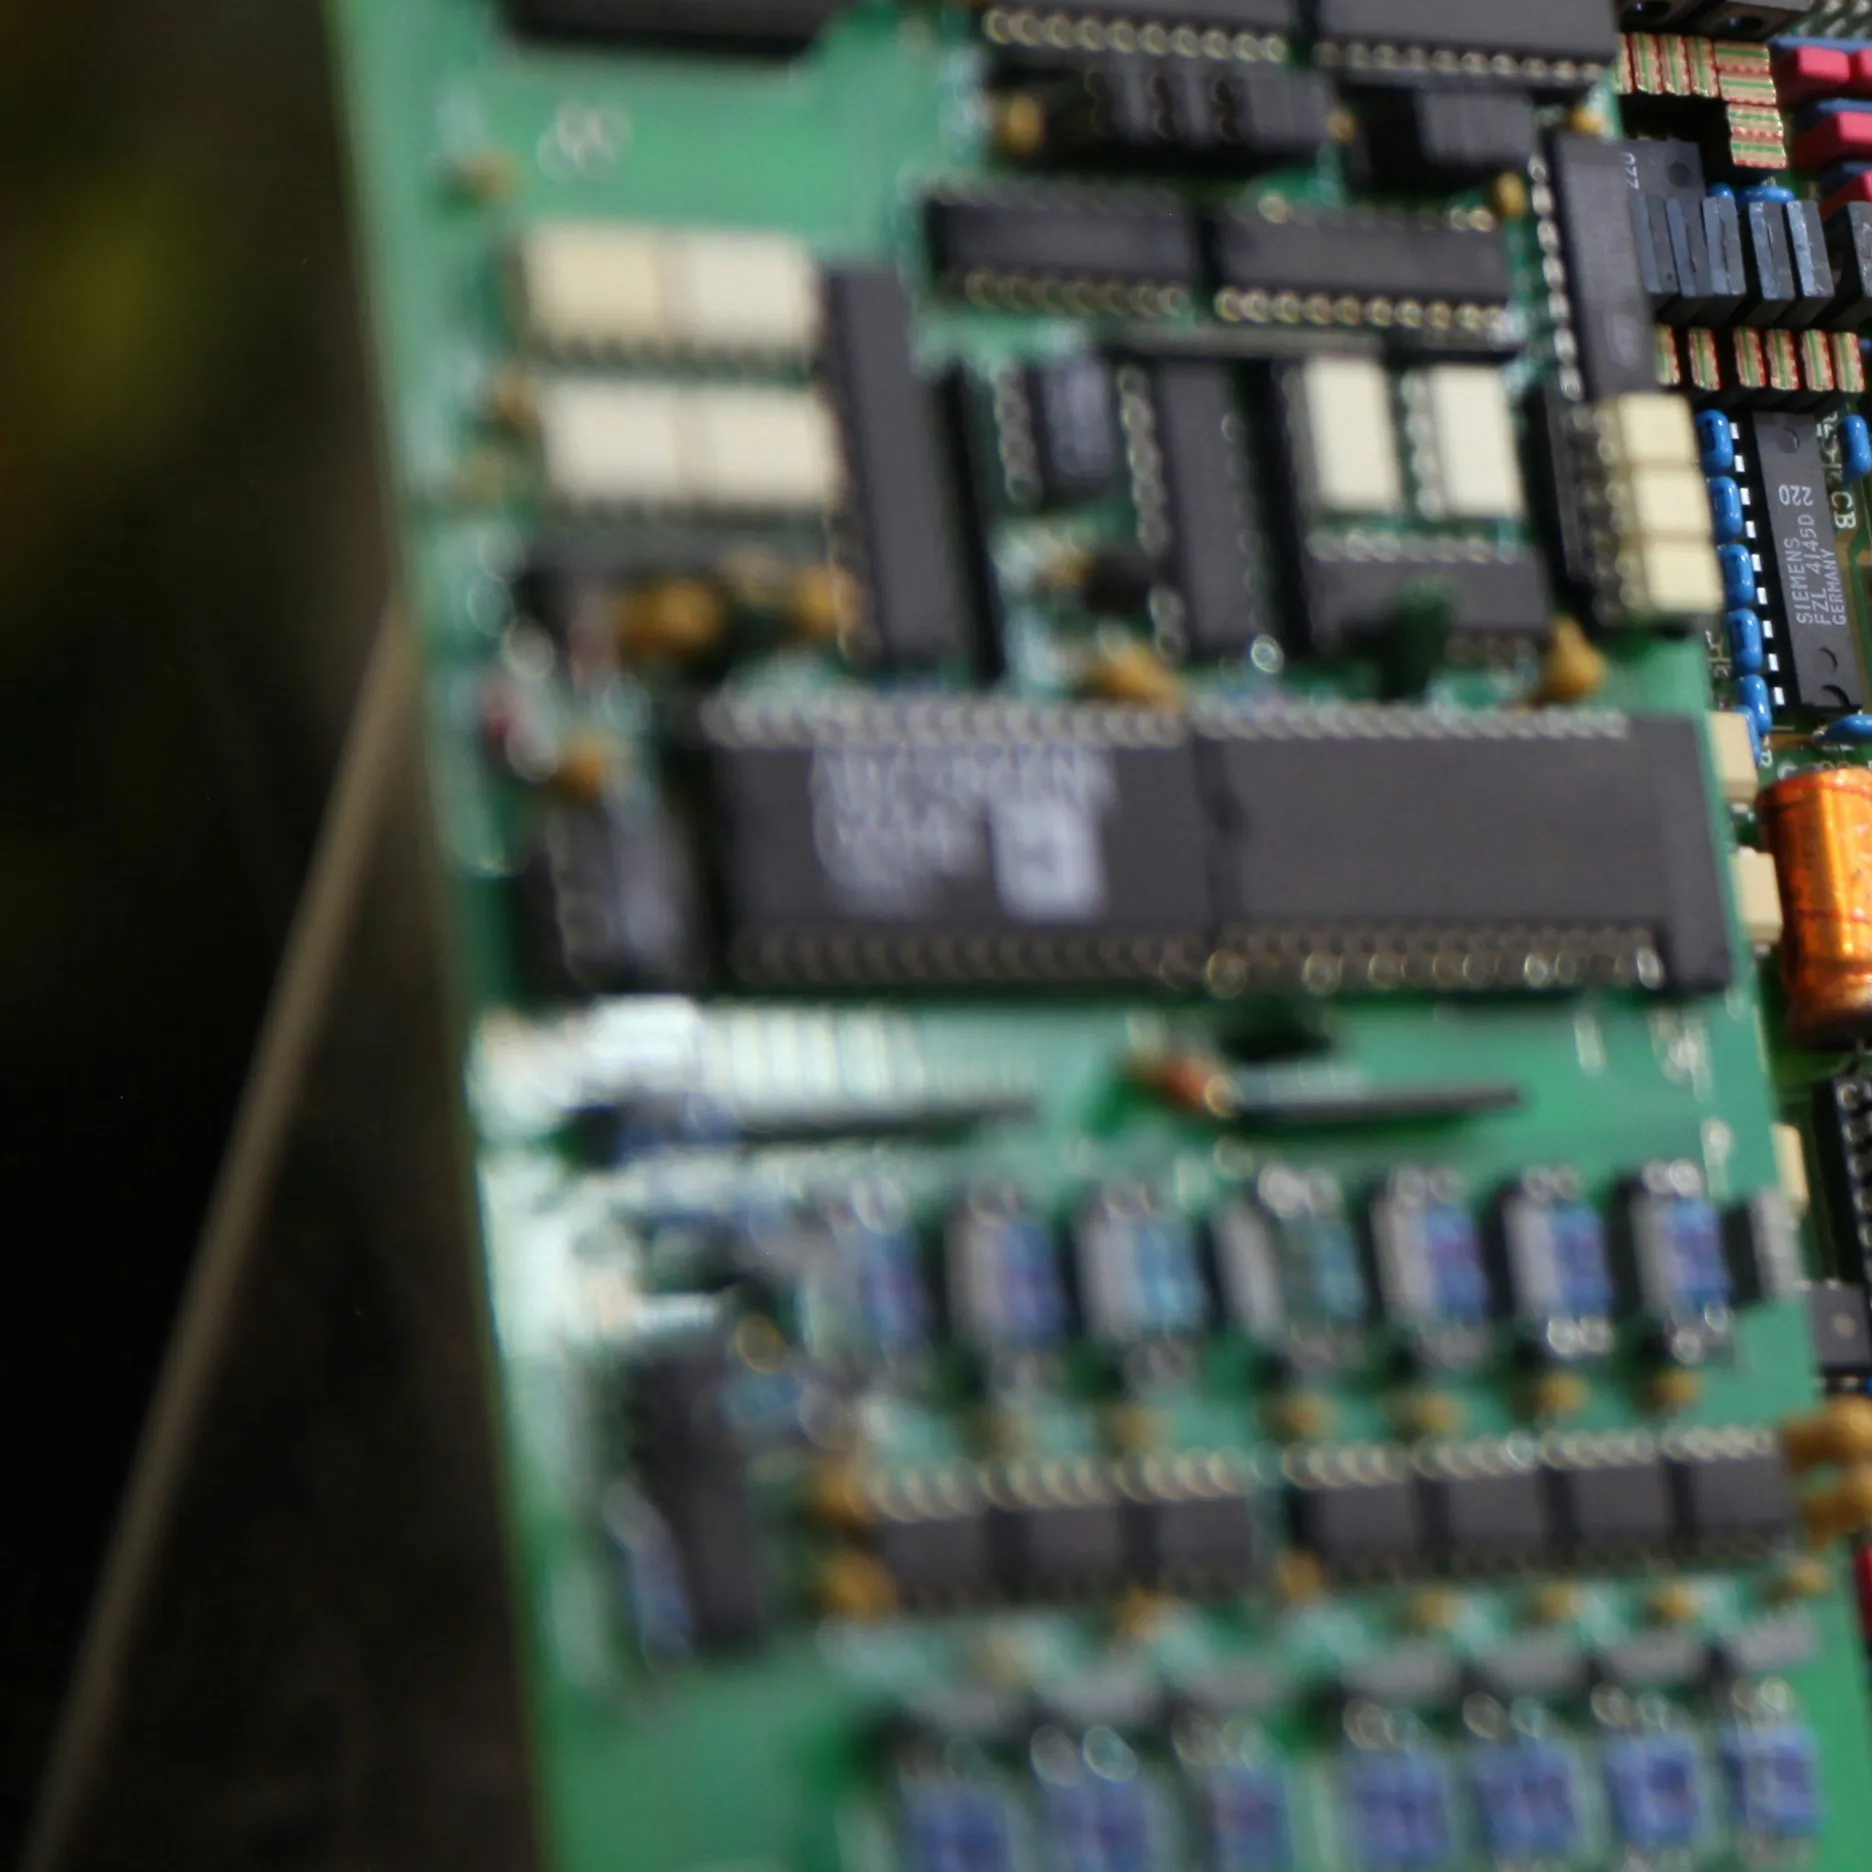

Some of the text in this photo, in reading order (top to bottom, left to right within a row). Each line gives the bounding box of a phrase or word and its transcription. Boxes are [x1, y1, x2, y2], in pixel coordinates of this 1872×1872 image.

[1777, 485, 1814, 506] 220
[1782, 536, 1814, 625] SIEMENS
[1809, 587, 1832, 626] FZL
[1821, 547, 1848, 626] GERMANY
